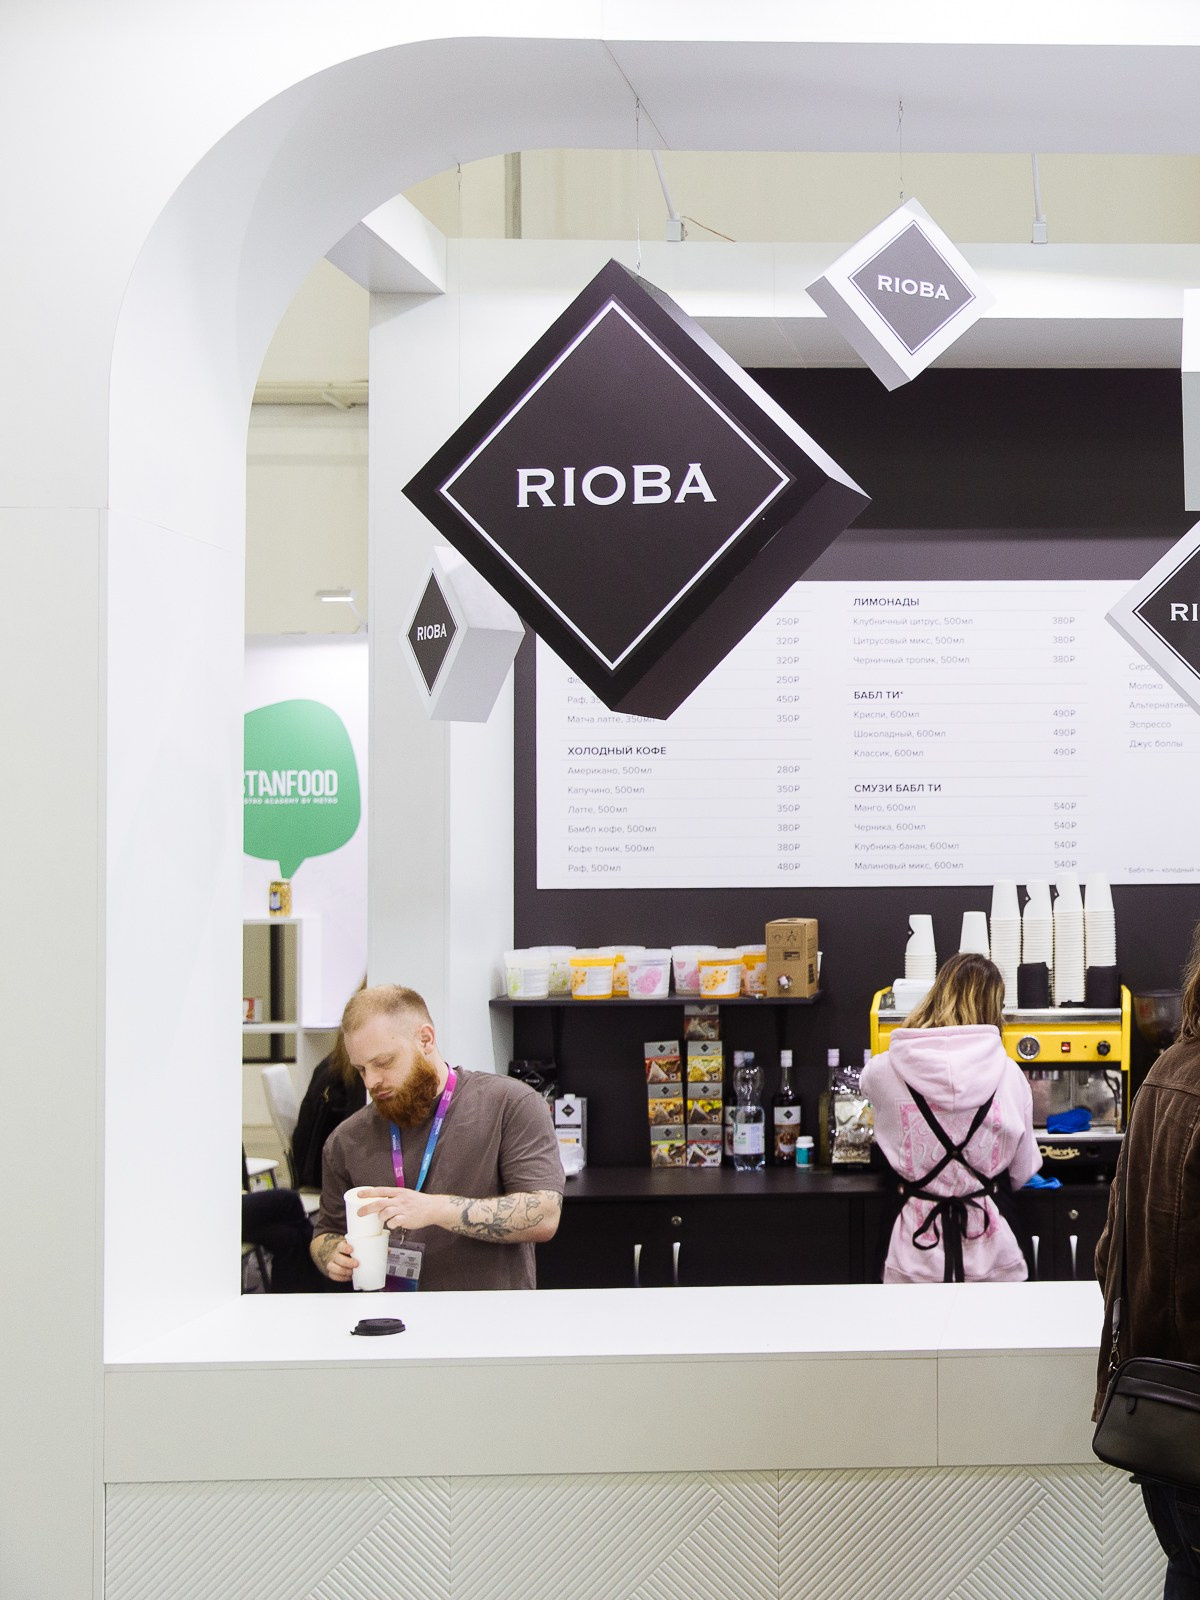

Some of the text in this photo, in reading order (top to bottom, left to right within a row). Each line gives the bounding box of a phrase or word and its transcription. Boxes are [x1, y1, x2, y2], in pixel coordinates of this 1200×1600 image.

[877, 274, 951, 301] RIOBA
[516, 462, 718, 508] RIOBA
[853, 598, 919, 607] ЛИМОНАДЫ
[776, 618, 799, 626] 250₽
[853, 617, 908, 626] Клубничный
[944, 617, 973, 625] 500мл
[417, 623, 448, 641] RIOBA
[776, 637, 799, 645] 320₽
[853, 637, 907, 646] Цитрусовый
[776, 657, 799, 665] 320₽
[853, 656, 903, 664] Черничный
[776, 676, 800, 684] 250₽
[1129, 682, 1165, 690] Молоко
[854, 691, 883, 699] БАБЛ
[776, 715, 800, 723] 350₽
[1129, 721, 1171, 729] Эспрессо
[1129, 740, 1152, 748] Джус
[1155, 740, 1183, 748] боллы
[568, 745, 666, 756] ХОЛОДНЫЙ КОФЕ
[894, 749, 924, 757] 600мл
[242, 769, 338, 797] TANFOOD
[615, 786, 645, 794] 500мл
[777, 785, 800, 793] 350₽
[854, 784, 942, 792] СМУЗИ БАБЛ ТИ
[777, 804, 800, 812] 350₽
[568, 825, 596, 833] Бамбл
[777, 824, 800, 832] 380₽
[568, 845, 592, 853] Кофе
[625, 844, 654, 852] 500мл
[777, 843, 800, 851] 380₽
[930, 842, 959, 850] 600мл
[591, 864, 621, 872] 500мл
[777, 863, 800, 871] 480₽
[854, 862, 906, 870] Малиновый
